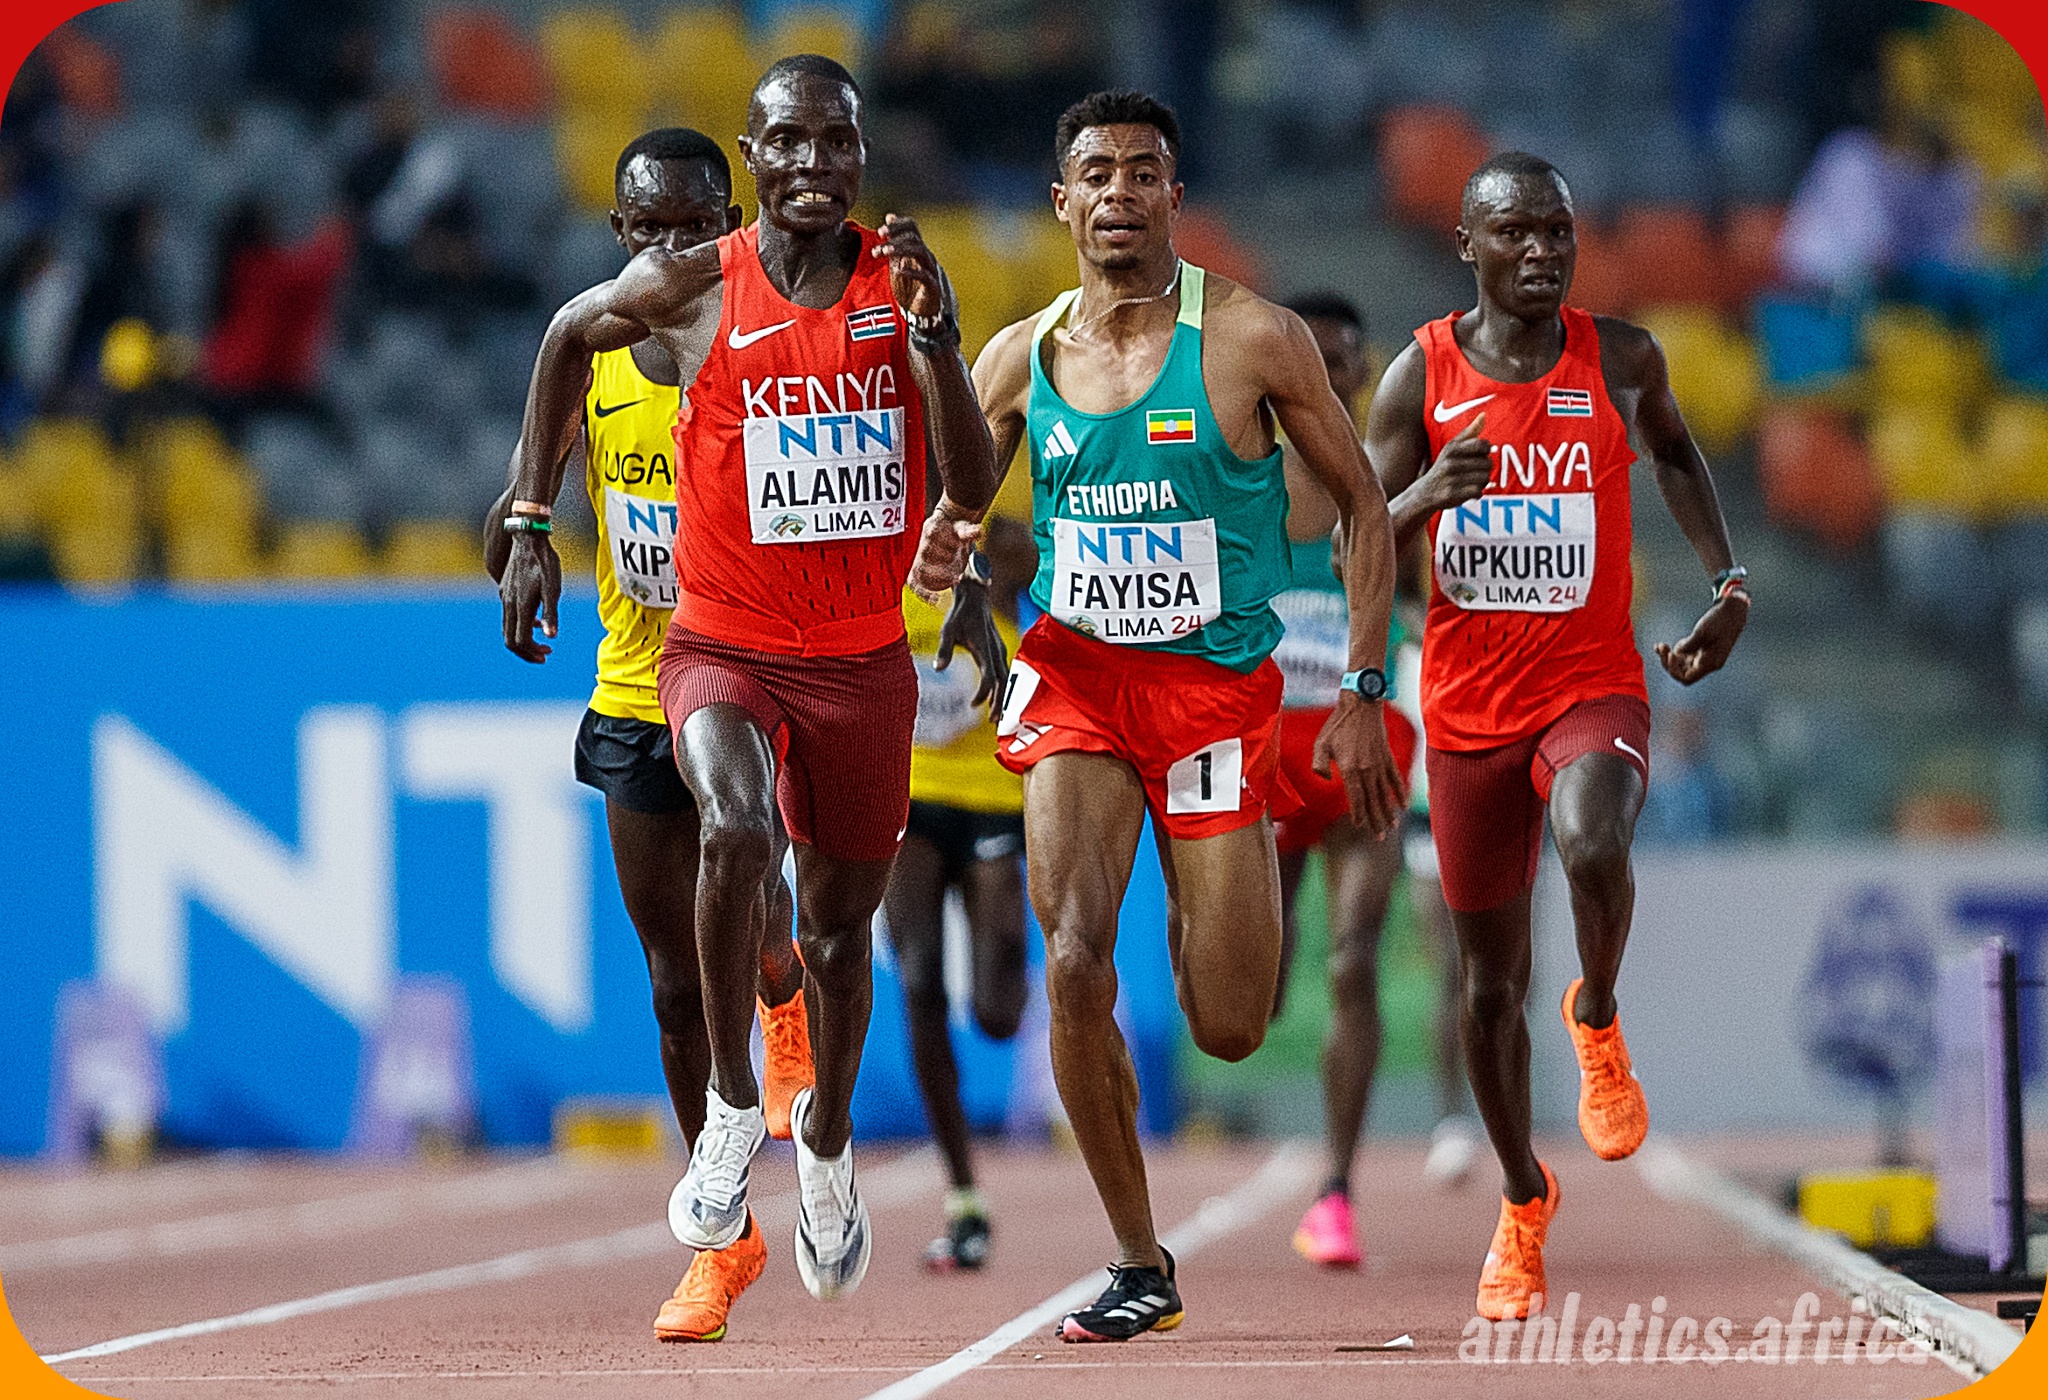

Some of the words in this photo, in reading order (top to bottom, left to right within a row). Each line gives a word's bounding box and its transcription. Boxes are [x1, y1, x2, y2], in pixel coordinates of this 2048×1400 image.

[742, 364, 896, 419] KENYA
[778, 412, 893, 459] NTN
[605, 451, 676, 486] UGA
[760, 461, 905, 509] ALAMIS
[1067, 480, 1178, 517] ETHIOPIA
[1455, 498, 1561, 536] NTN
[814, 510, 876, 533] LIMA
[620, 538, 678, 578] KIP
[1077, 526, 1183, 566] NTN
[1442, 542, 1585, 579] KIPKURUI
[1068, 571, 1200, 610] FAYISA
[1485, 585, 1541, 604] LIMA
[1547, 585, 1577, 604] 24
[1105, 617, 1164, 637] LIMA
[1171, 614, 1202, 635] 24
[1193, 750, 1212, 800] 1
